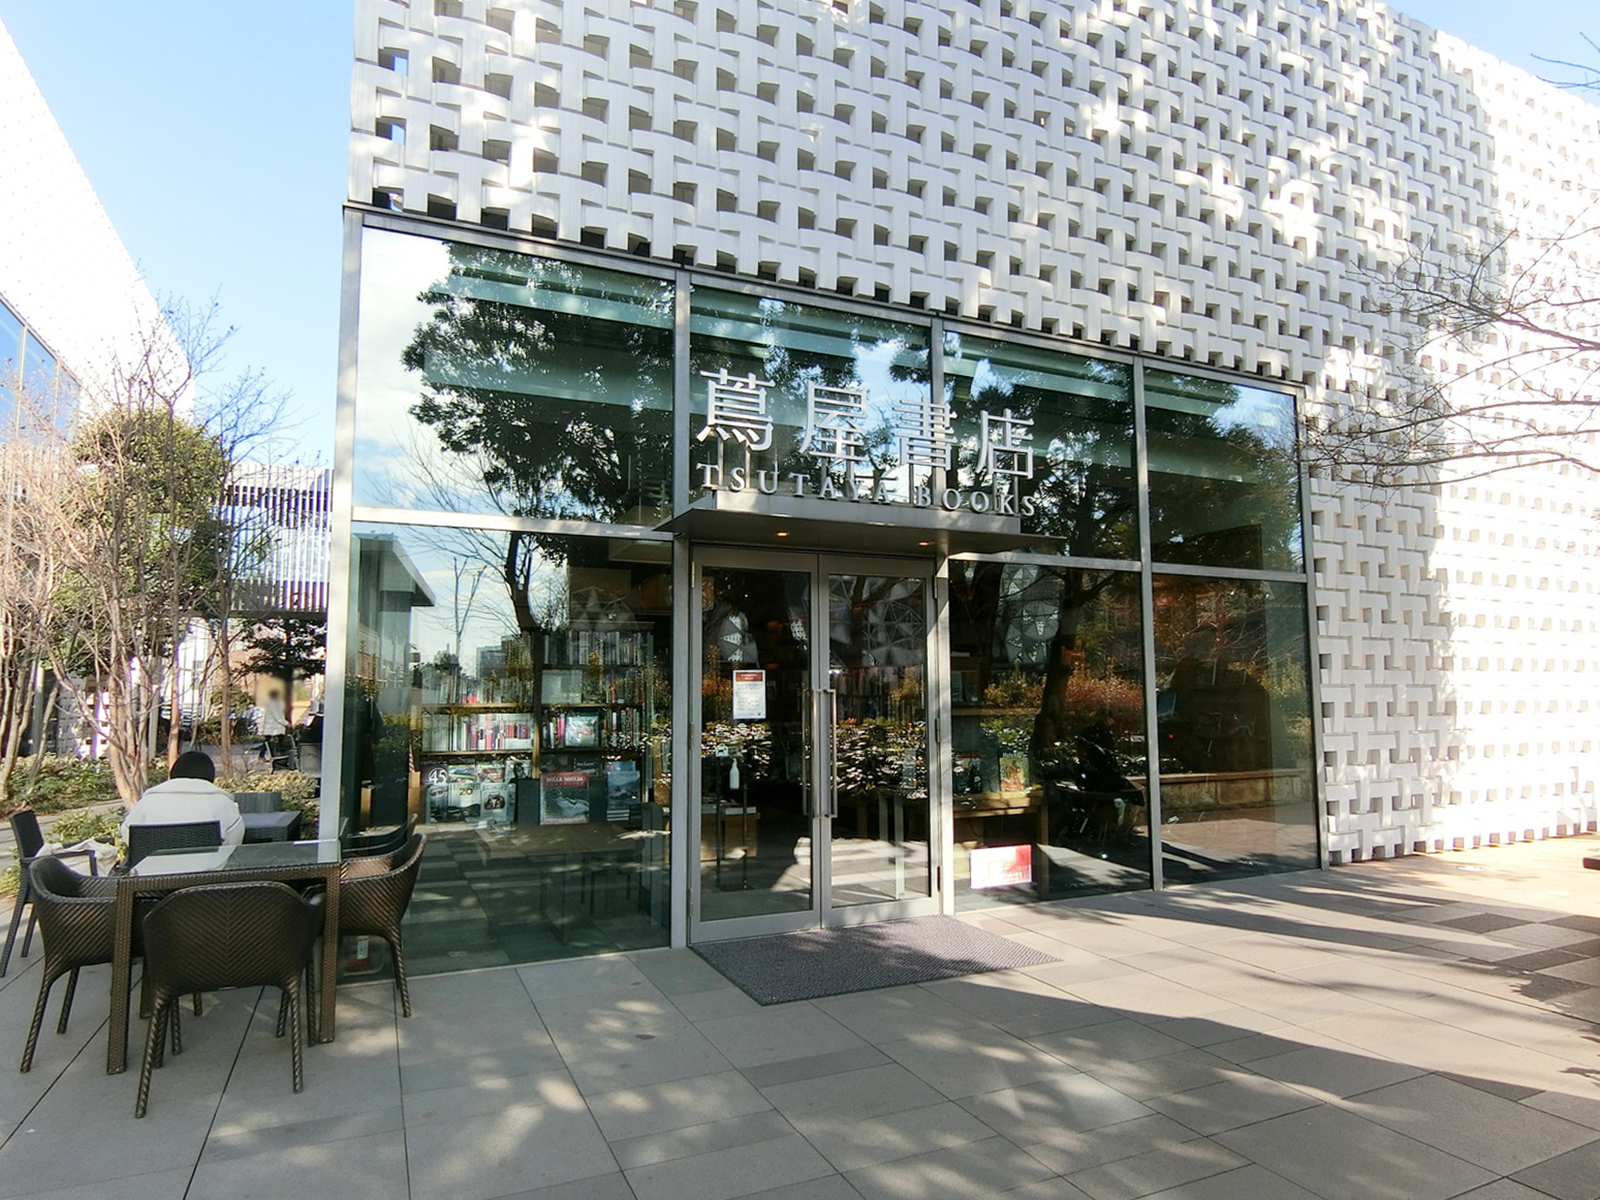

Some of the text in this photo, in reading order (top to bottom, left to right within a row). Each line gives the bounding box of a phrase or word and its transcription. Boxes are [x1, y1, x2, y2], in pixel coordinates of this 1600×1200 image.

[697, 367, 1035, 479] 蔦屋書店
[696, 463, 1035, 517] TSUTAYA BOOKS
